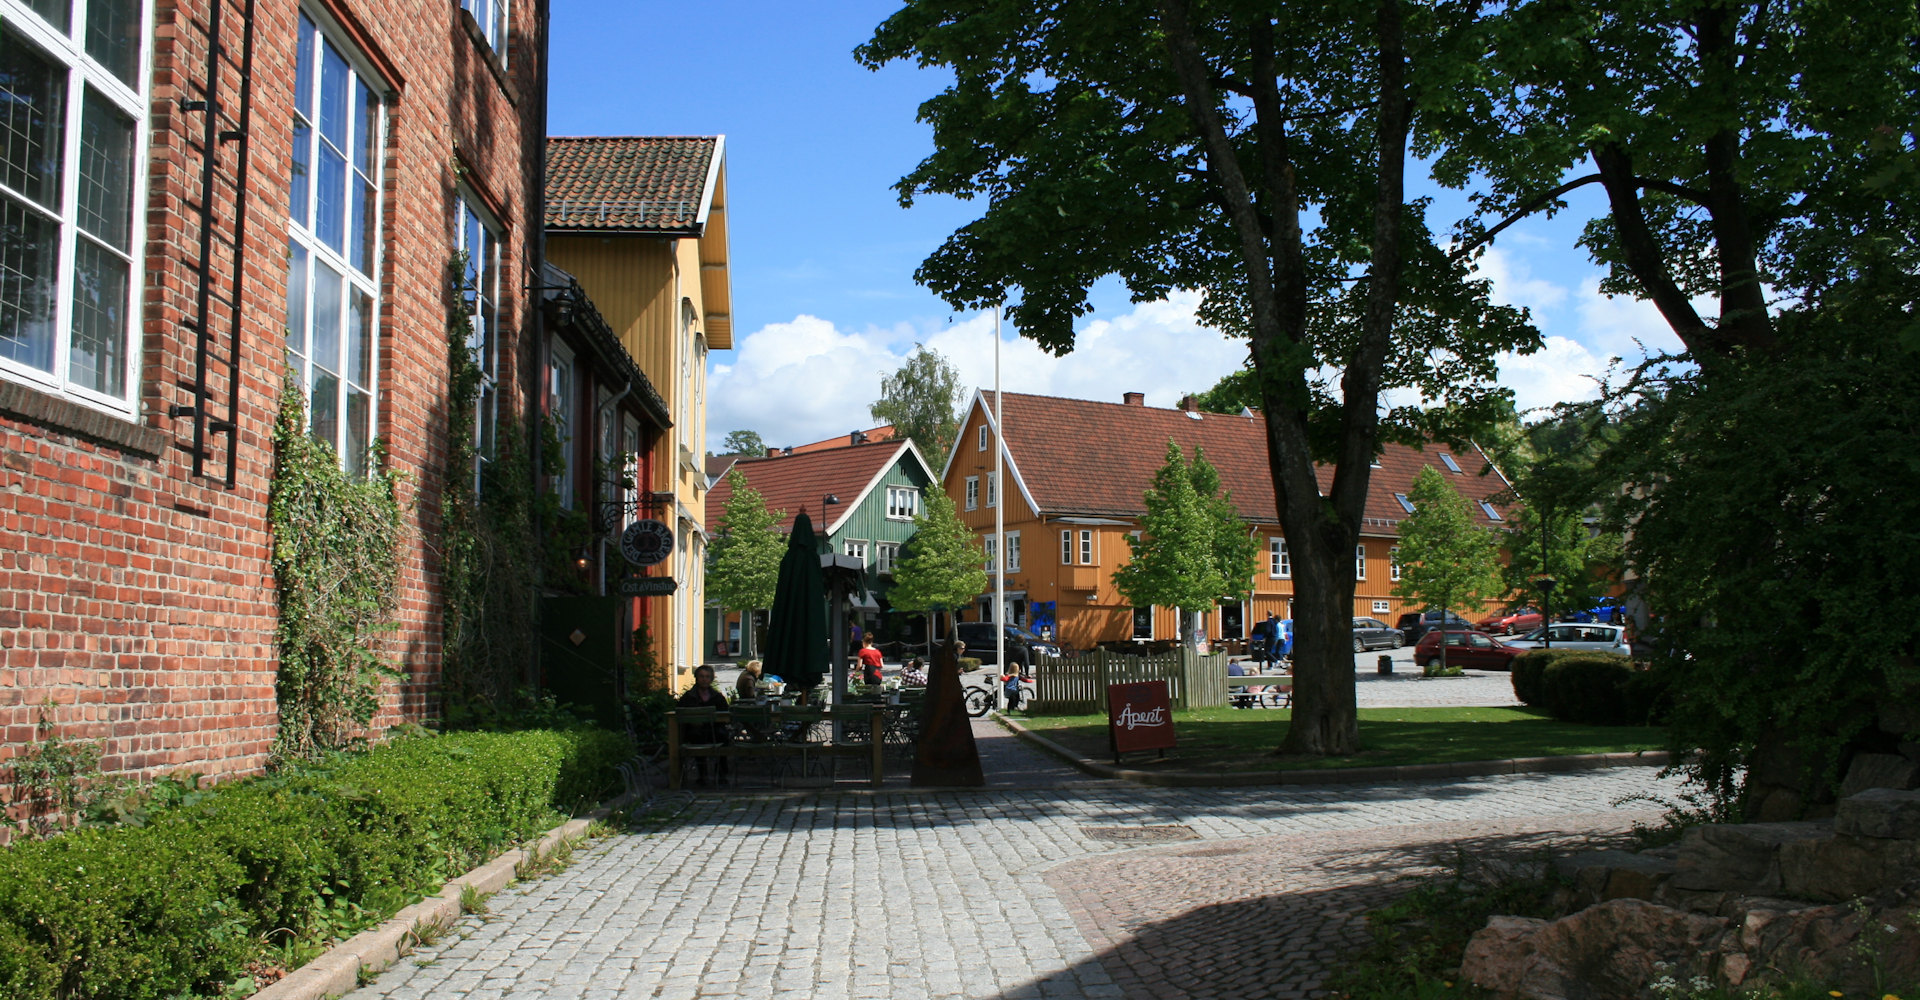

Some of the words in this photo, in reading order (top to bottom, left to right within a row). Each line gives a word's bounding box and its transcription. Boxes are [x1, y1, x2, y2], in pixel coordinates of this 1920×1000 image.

[623, 543, 642, 561] DET
[651, 524, 672, 561] BAGERI
[1116, 703, 1166, 731] Åpent
